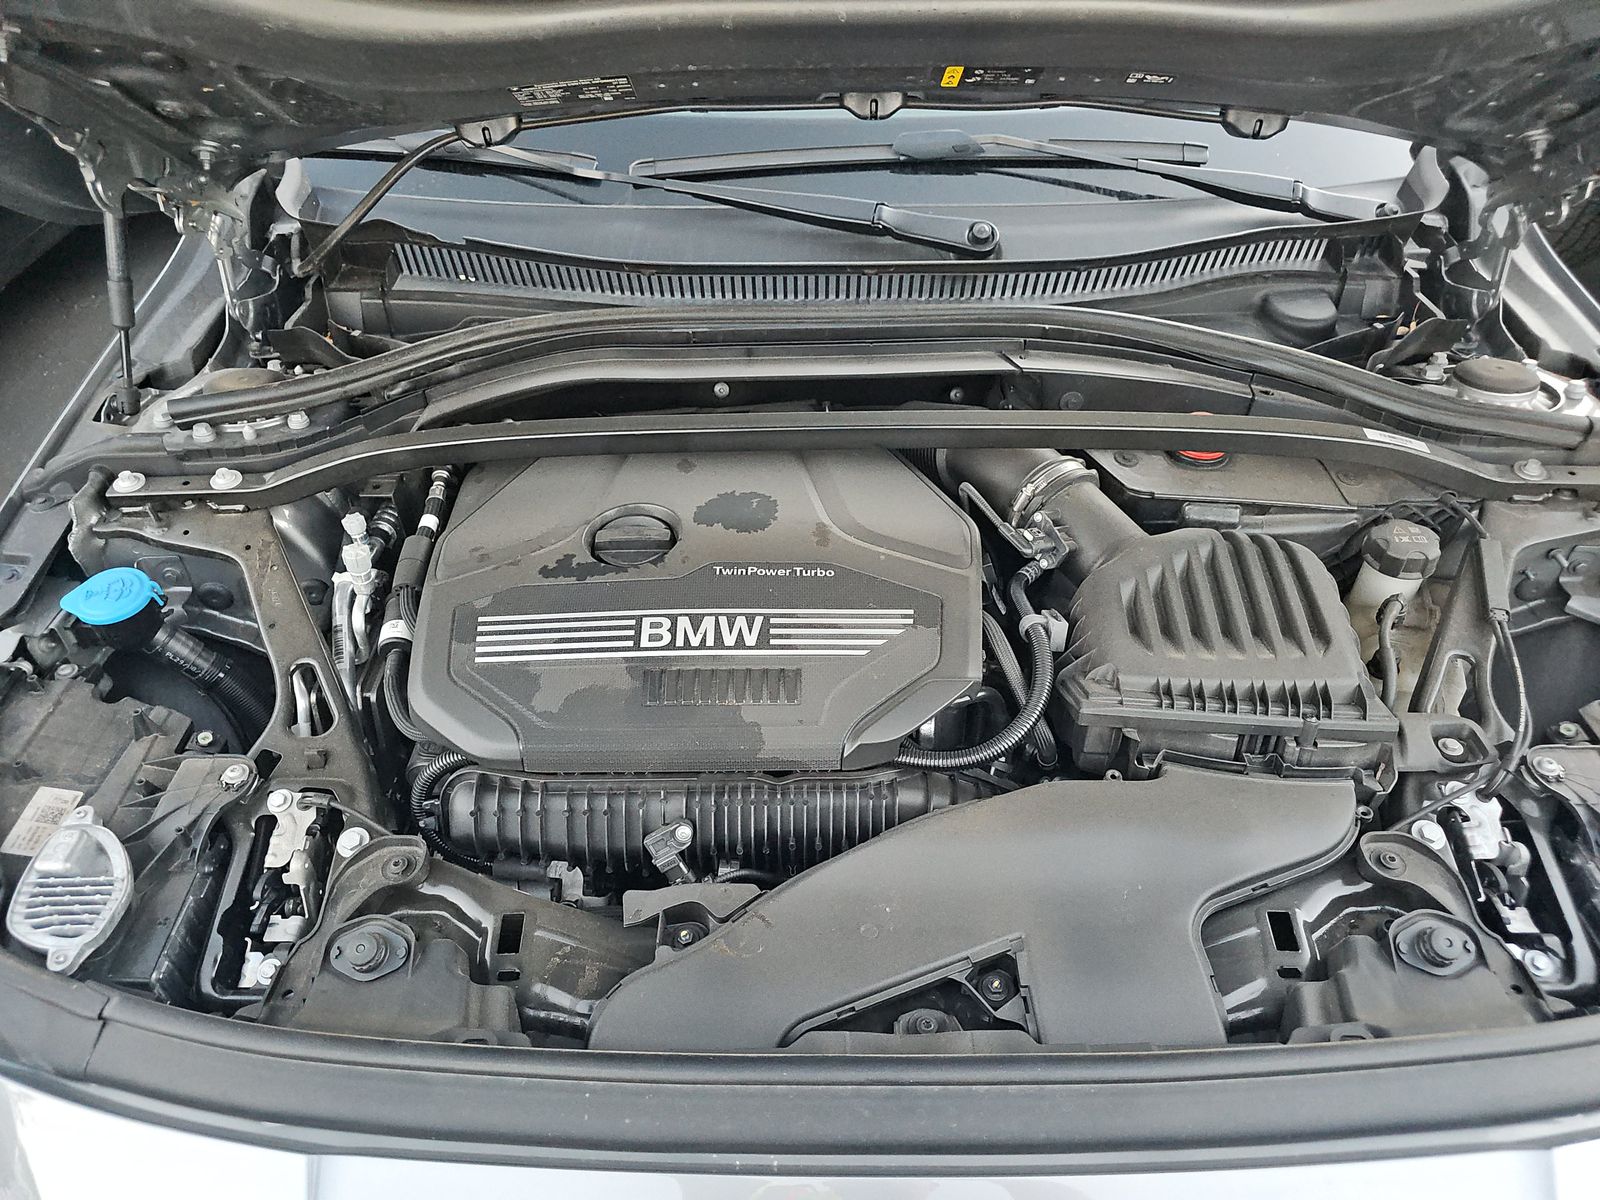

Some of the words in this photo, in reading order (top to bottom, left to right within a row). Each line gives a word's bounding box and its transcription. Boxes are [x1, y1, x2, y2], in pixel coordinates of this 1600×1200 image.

[712, 566, 792, 577] TwinPower
[793, 566, 835, 577] Turbo
[639, 615, 764, 648] BMW
